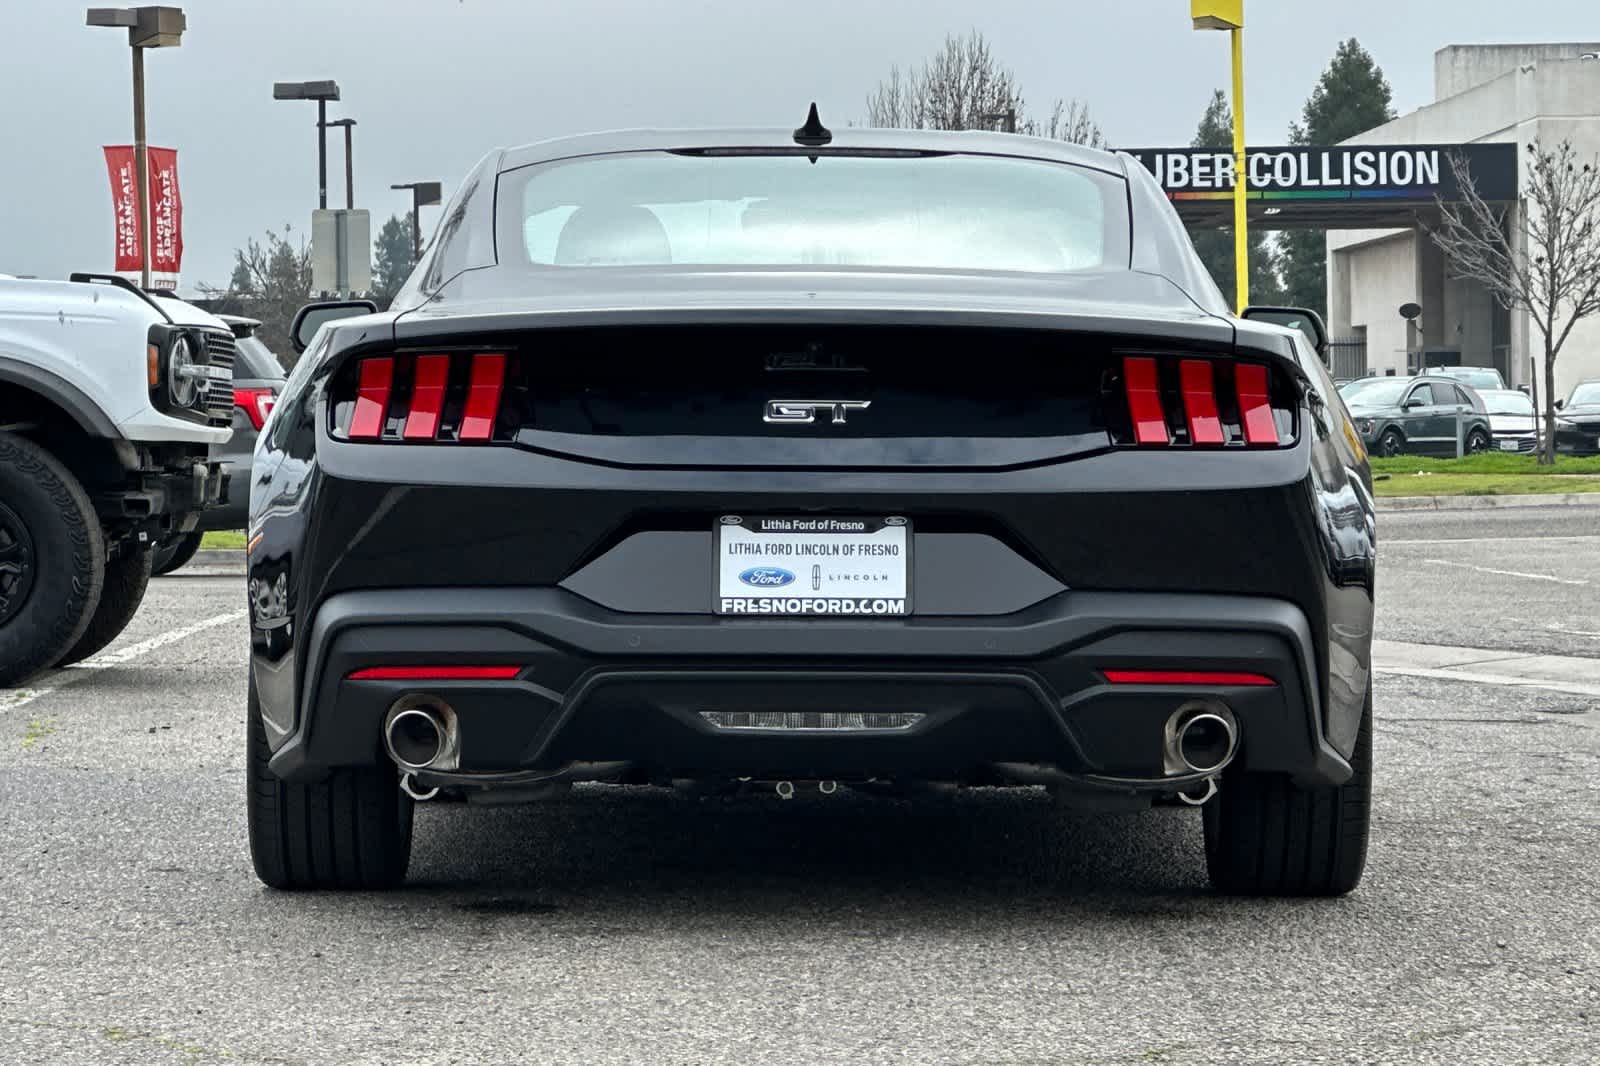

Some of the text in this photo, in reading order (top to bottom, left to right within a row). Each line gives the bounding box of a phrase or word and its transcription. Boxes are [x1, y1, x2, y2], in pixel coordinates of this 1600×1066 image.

[1250, 150, 1440, 187] COLLISION
[763, 400, 872, 423] GT
[761, 520, 865, 530] Lithia Ford of Fresno
[729, 543, 899, 556] LITHIA FORD LINCOLN OF FRESNO
[750, 570, 785, 585] Ford
[721, 599, 905, 614] FRESNOFORD.COM
